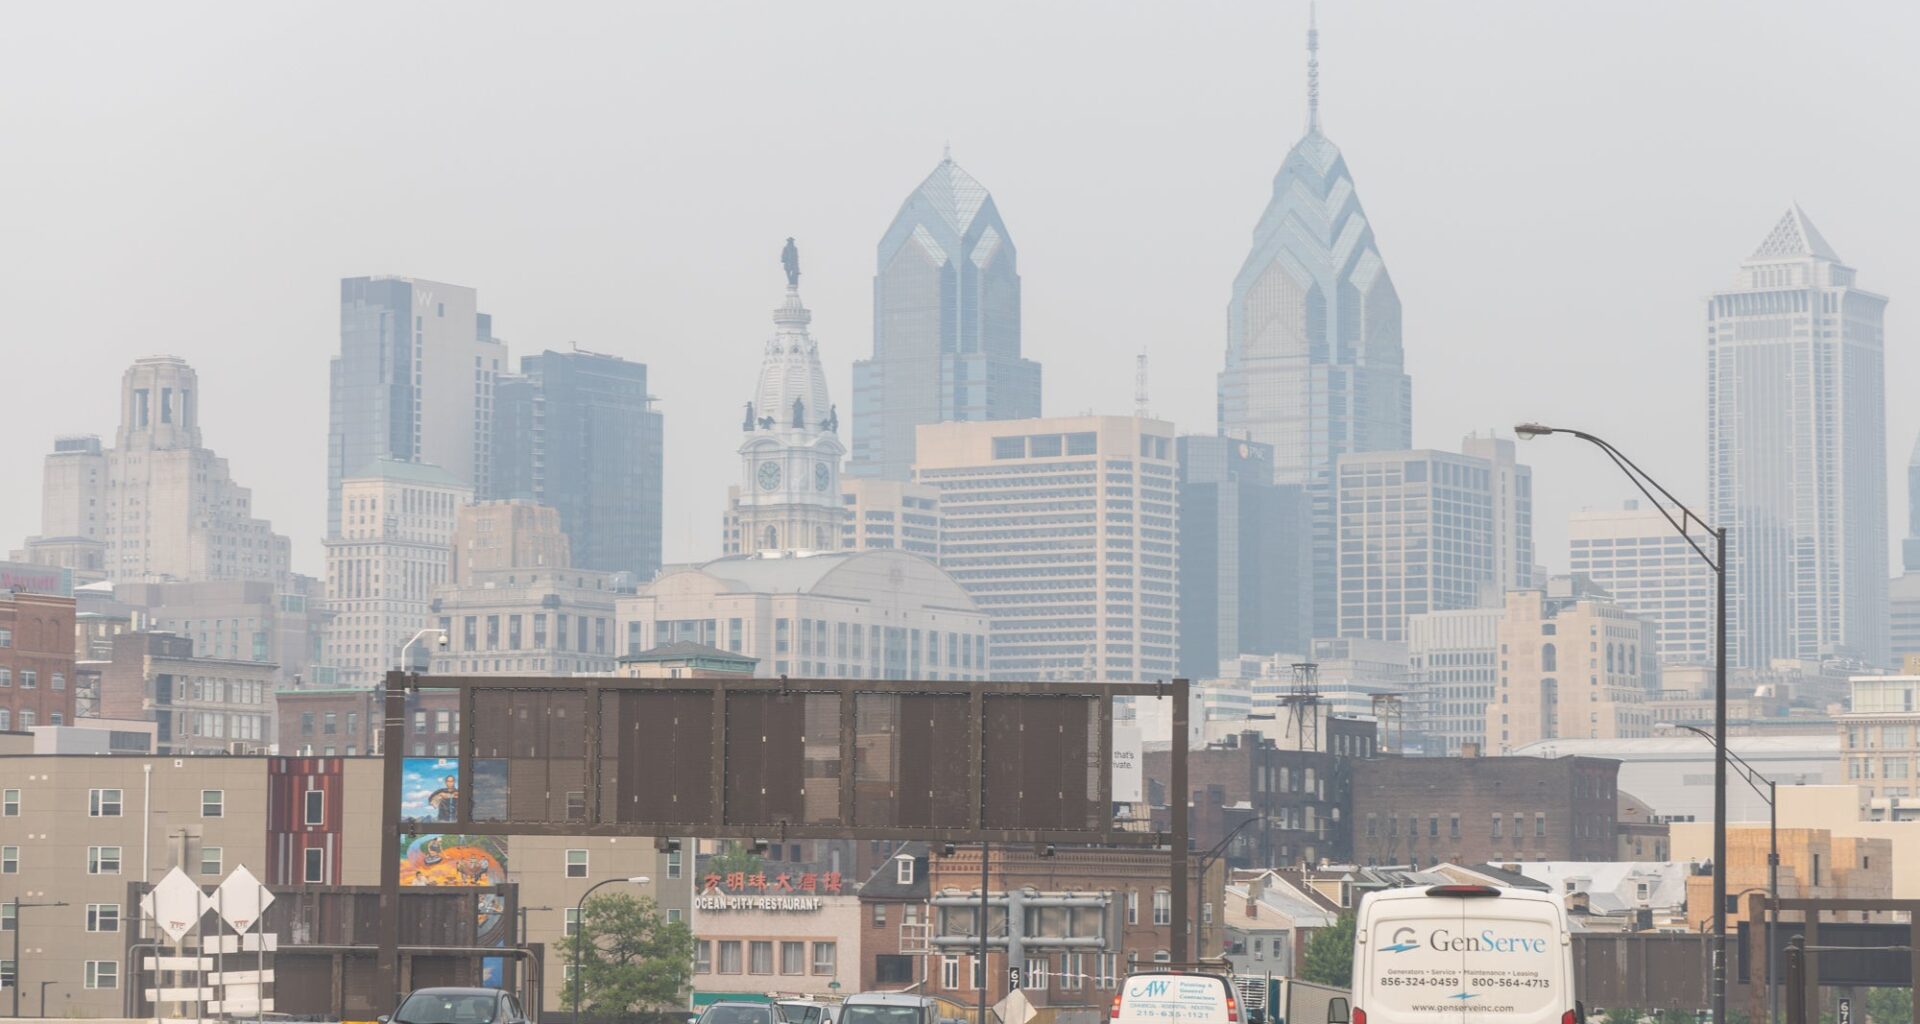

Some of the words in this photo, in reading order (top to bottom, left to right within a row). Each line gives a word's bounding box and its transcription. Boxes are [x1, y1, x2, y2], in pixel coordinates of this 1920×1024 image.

[415, 289, 432, 307] W
[695, 871, 842, 893] 方明珠大酒樓
[695, 897, 726, 910] OCEAN
[730, 897, 753, 910] CITY
[759, 897, 820, 911] RESTAURANT
[1430, 928, 1546, 954] GenServe
[1387, 968, 1424, 976] Generators
[1431, 968, 1456, 976] Service
[1463, 969, 1505, 977] Maintenance
[1512, 970, 1539, 978] Leasing
[1130, 980, 1171, 997] AW
[1380, 977, 1459, 987] 856-324-0459
[1471, 977, 1550, 988] 800-564-4713
[1412, 1003, 1515, 1013] www.genserveinc.com
